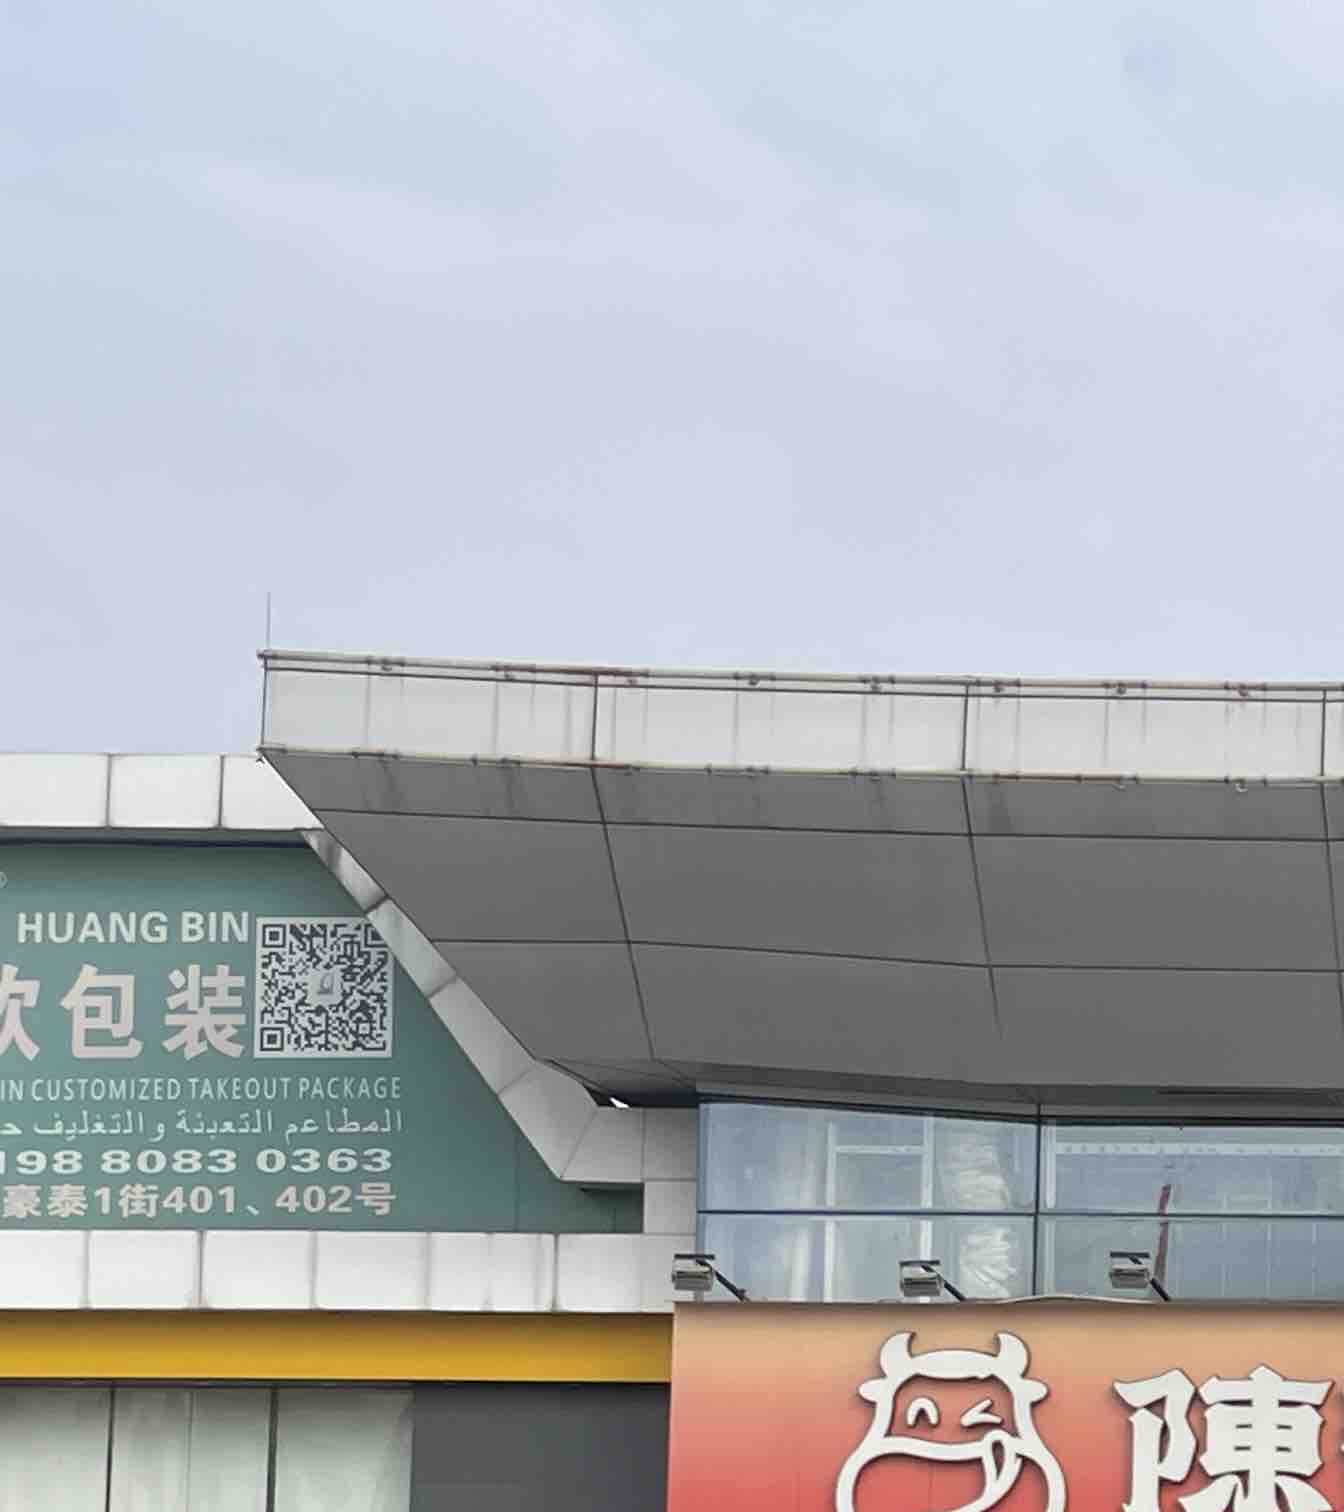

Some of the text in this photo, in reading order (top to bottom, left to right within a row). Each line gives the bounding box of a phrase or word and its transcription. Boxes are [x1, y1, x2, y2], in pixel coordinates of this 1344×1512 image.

[17, 911, 249, 944] HUANG BIN
[31, 1078, 181, 1101] CUSTOMIZED
[187, 1078, 291, 1100] TAKEOUT
[299, 1077, 401, 1100] PACKAGE
[100, 1149, 237, 1174] 8083
[256, 1148, 392, 1173] 0363
